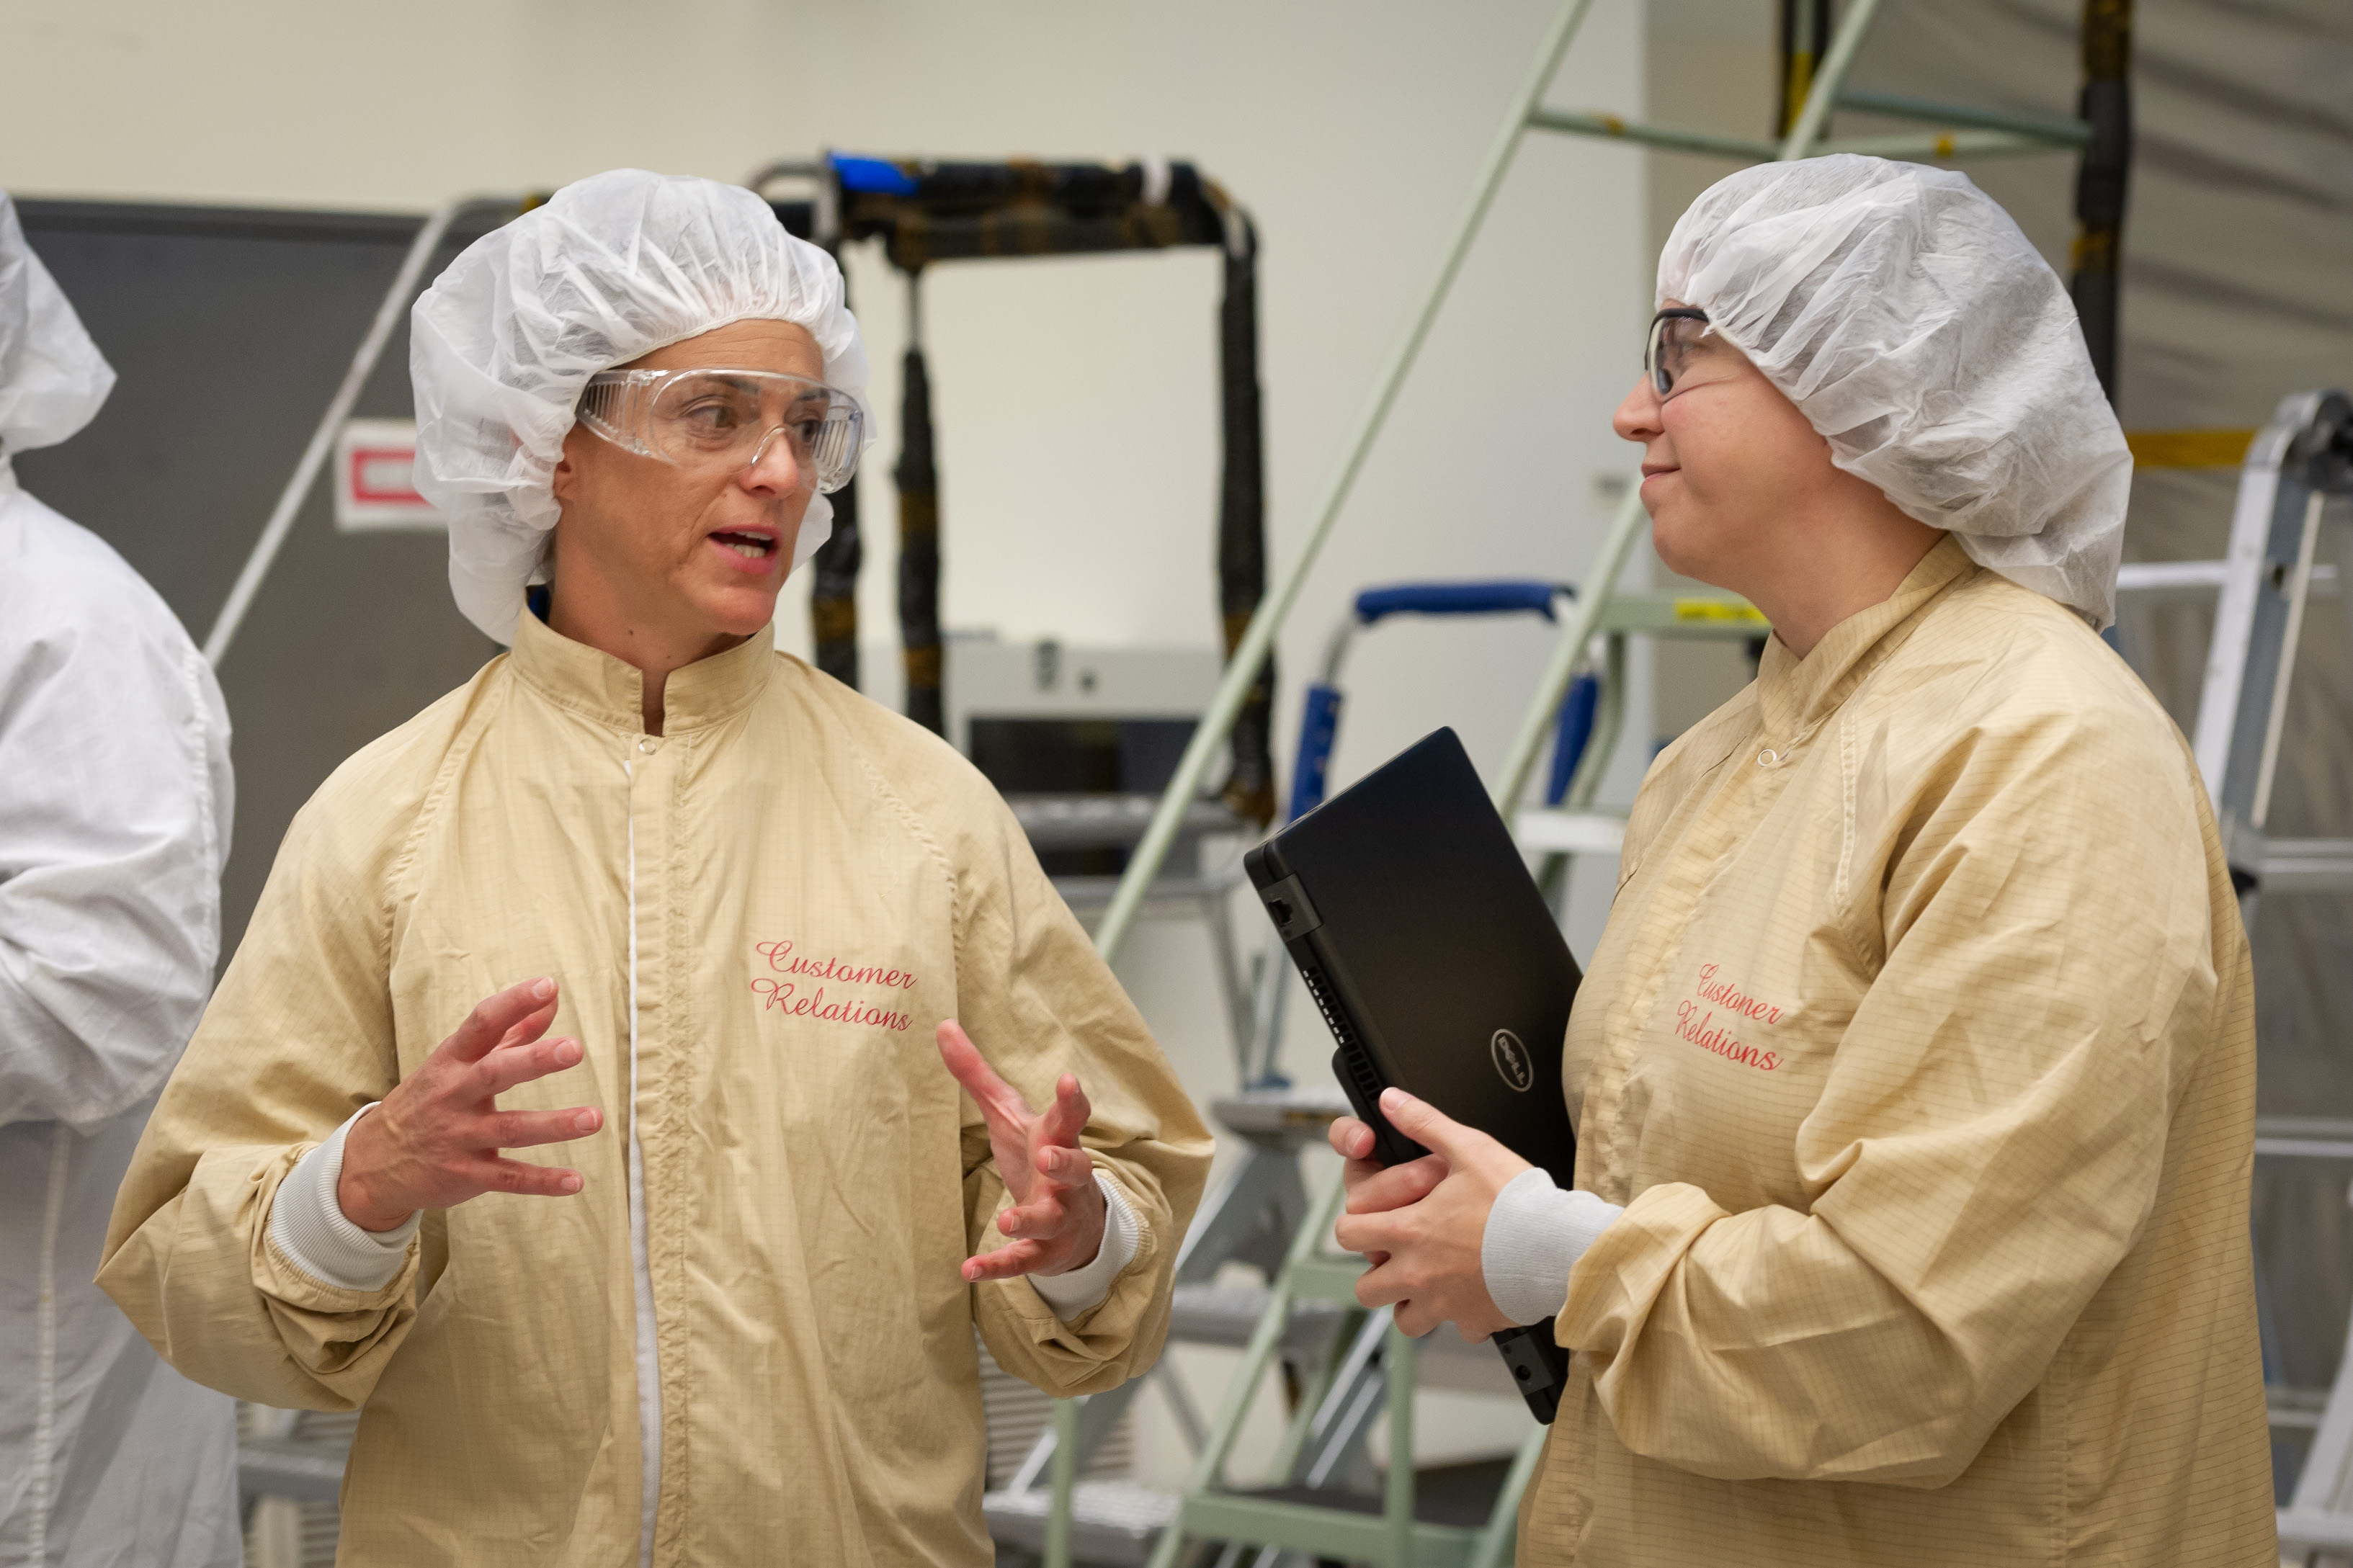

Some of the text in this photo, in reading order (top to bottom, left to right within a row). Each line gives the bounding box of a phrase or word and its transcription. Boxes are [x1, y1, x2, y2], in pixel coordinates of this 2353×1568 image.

[756, 940, 919, 990] Customer
[750, 978, 914, 1031] Relations
[1497, 1035, 1526, 1086] DELL
[1675, 1000, 1785, 1071] Relations
